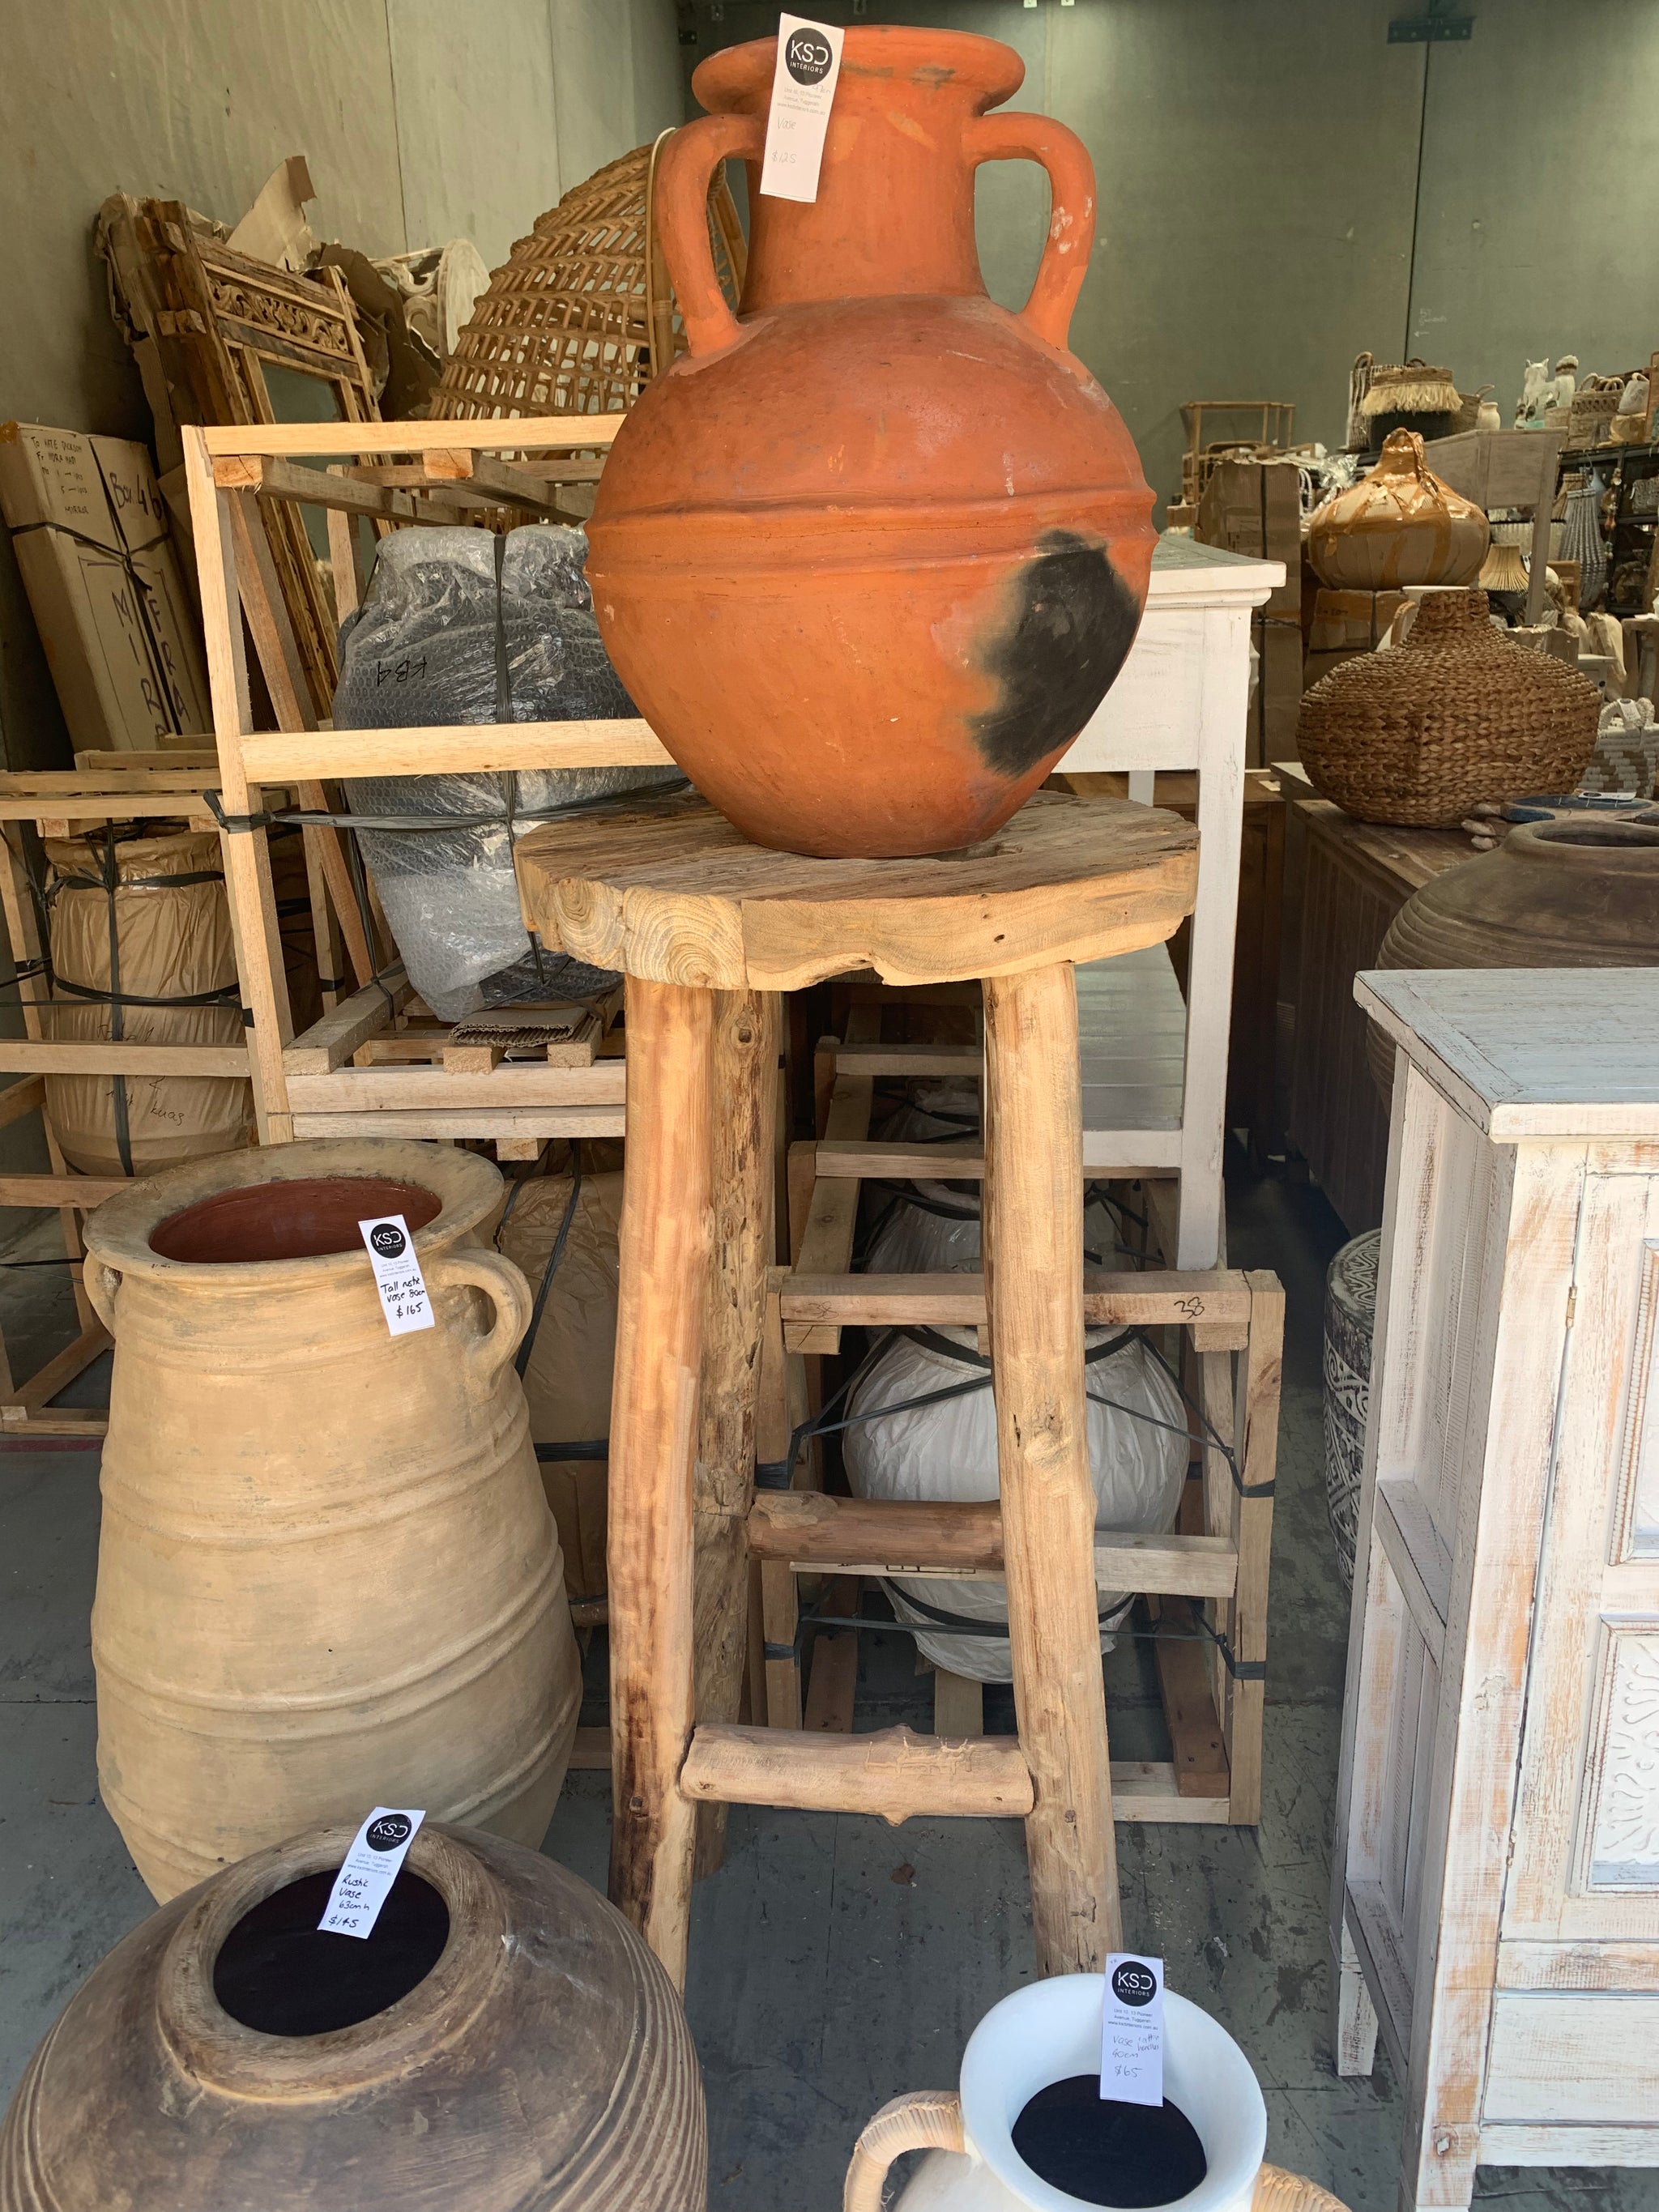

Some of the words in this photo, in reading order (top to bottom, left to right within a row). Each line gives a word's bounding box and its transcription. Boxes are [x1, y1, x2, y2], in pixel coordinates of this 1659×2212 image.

[790, 62, 824, 75] INTERIORS
[377, 1243, 403, 1251] INTERIORS
[380, 1281, 399, 1294] Tall
[369, 1834, 400, 1843] INTERIORS
[1117, 1988, 1150, 1997] INTERIORS
[1115, 2065, 1143, 2078] $65
